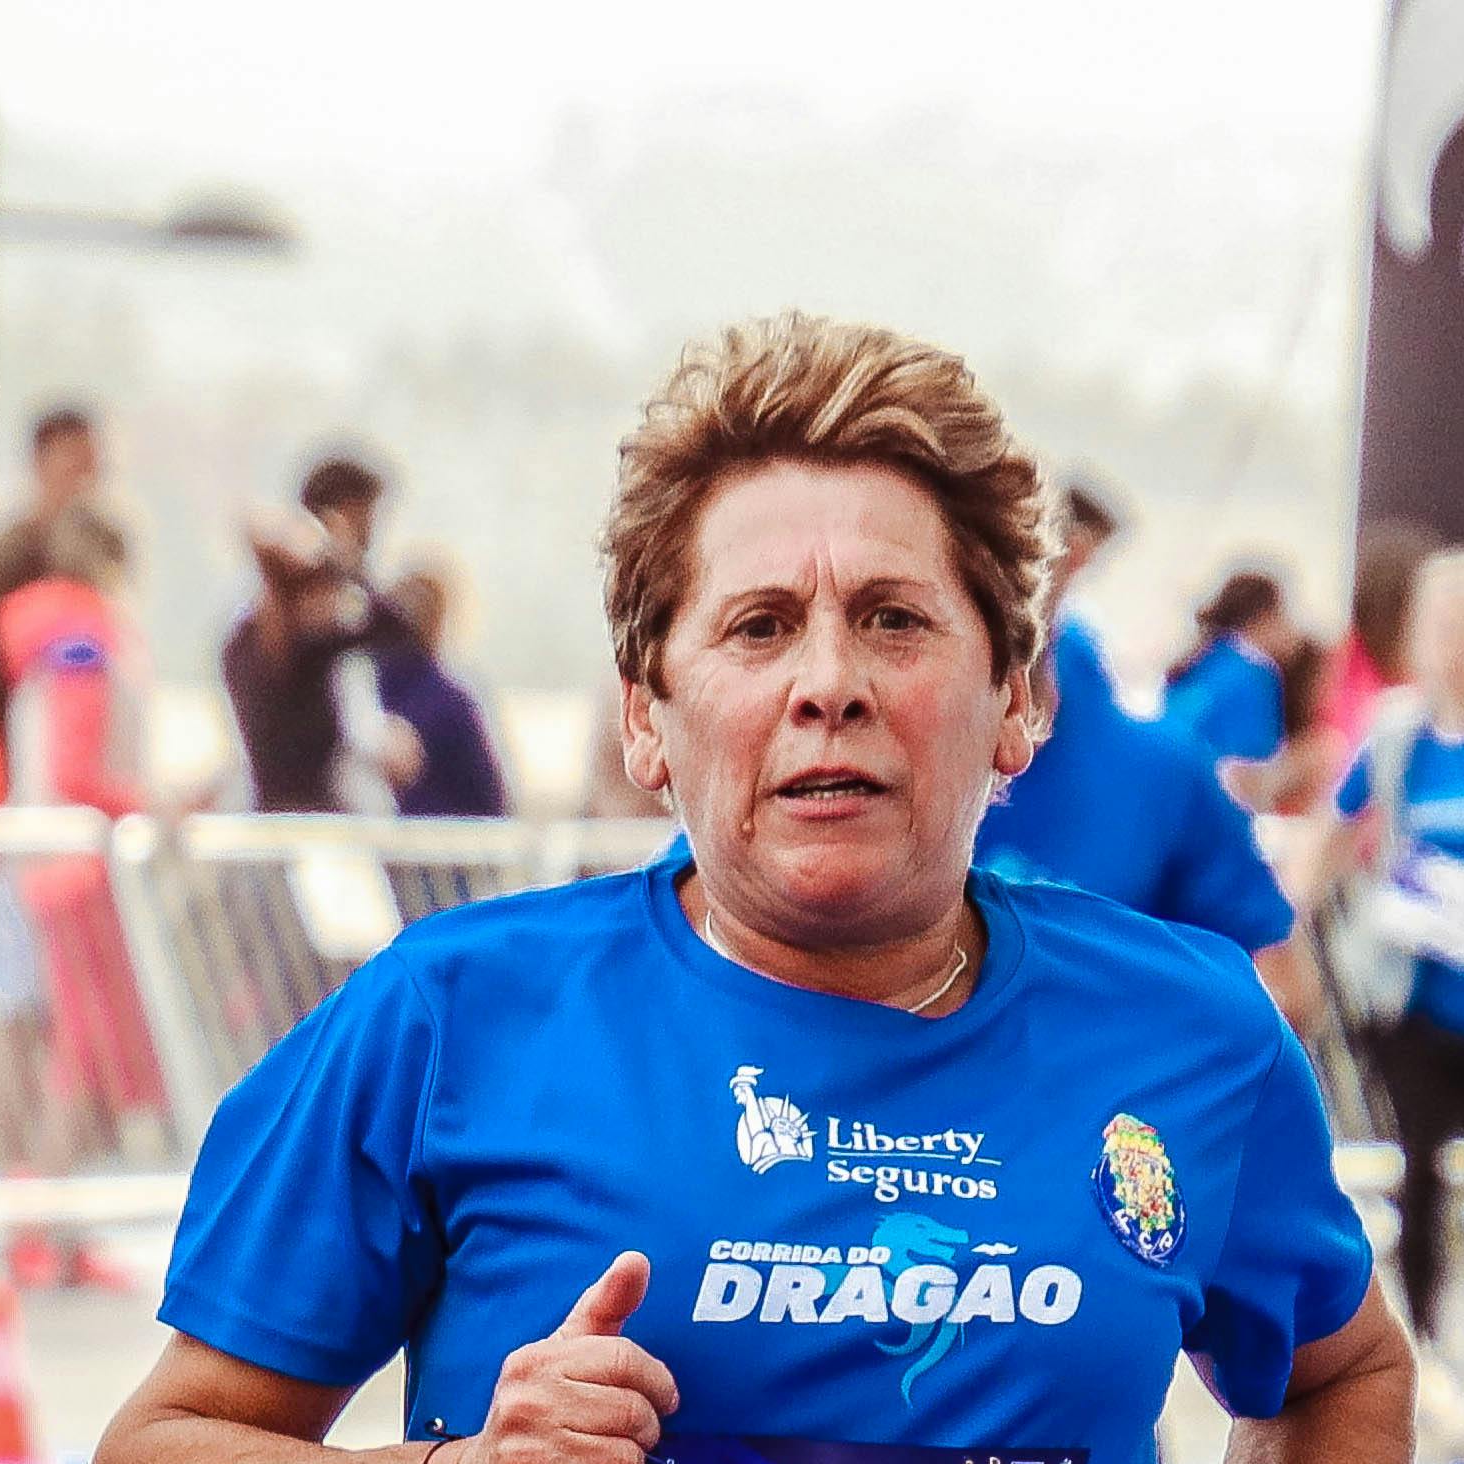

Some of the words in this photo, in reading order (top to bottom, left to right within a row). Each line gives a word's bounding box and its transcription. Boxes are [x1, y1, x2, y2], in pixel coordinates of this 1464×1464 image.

[827, 1115, 985, 1166] Liberty
[827, 1159, 998, 1203] Seguros
[709, 1239, 843, 1265] CORRIDA
[846, 1245, 891, 1266] DO
[692, 1241, 1083, 1326] DRAGÃO
